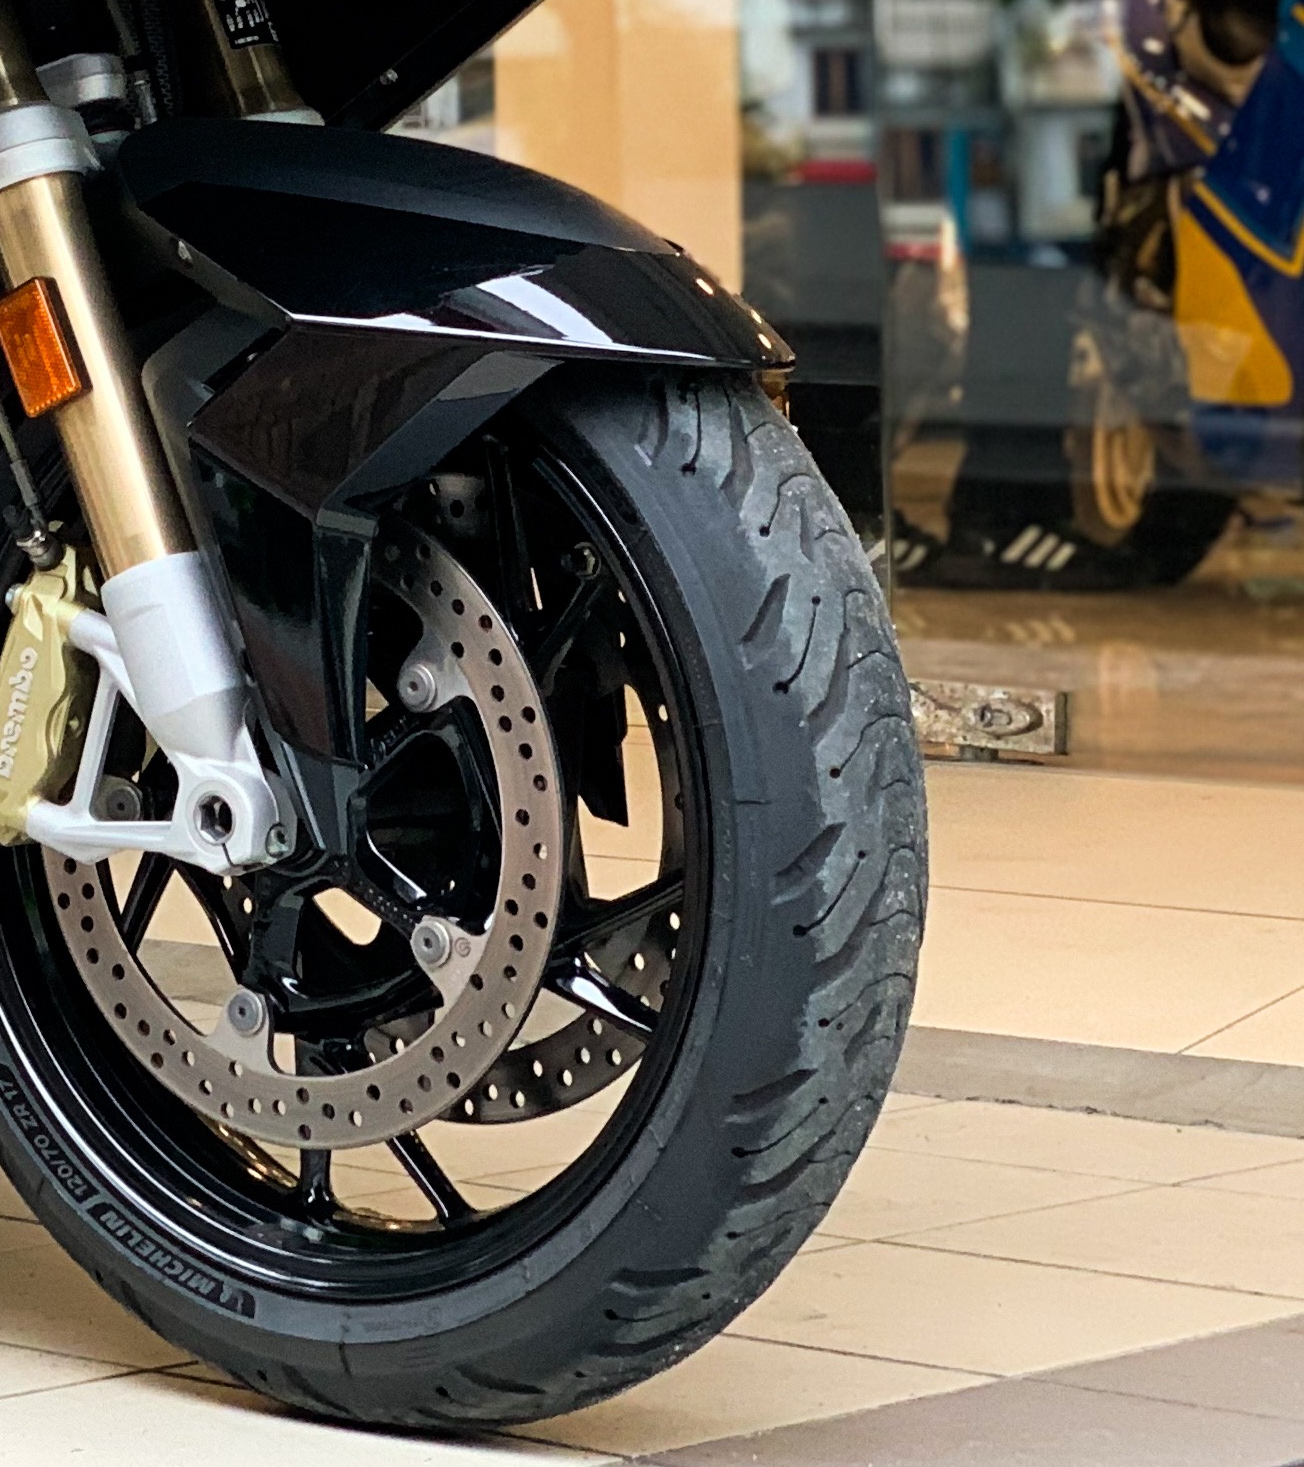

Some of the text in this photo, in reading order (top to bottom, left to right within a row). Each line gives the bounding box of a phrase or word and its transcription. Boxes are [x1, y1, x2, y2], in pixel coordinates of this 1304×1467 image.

[12, 1103, 39, 1130] ZR
[33, 1134, 88, 1196] 120/70
[99, 1209, 216, 1296] MICHELIN
